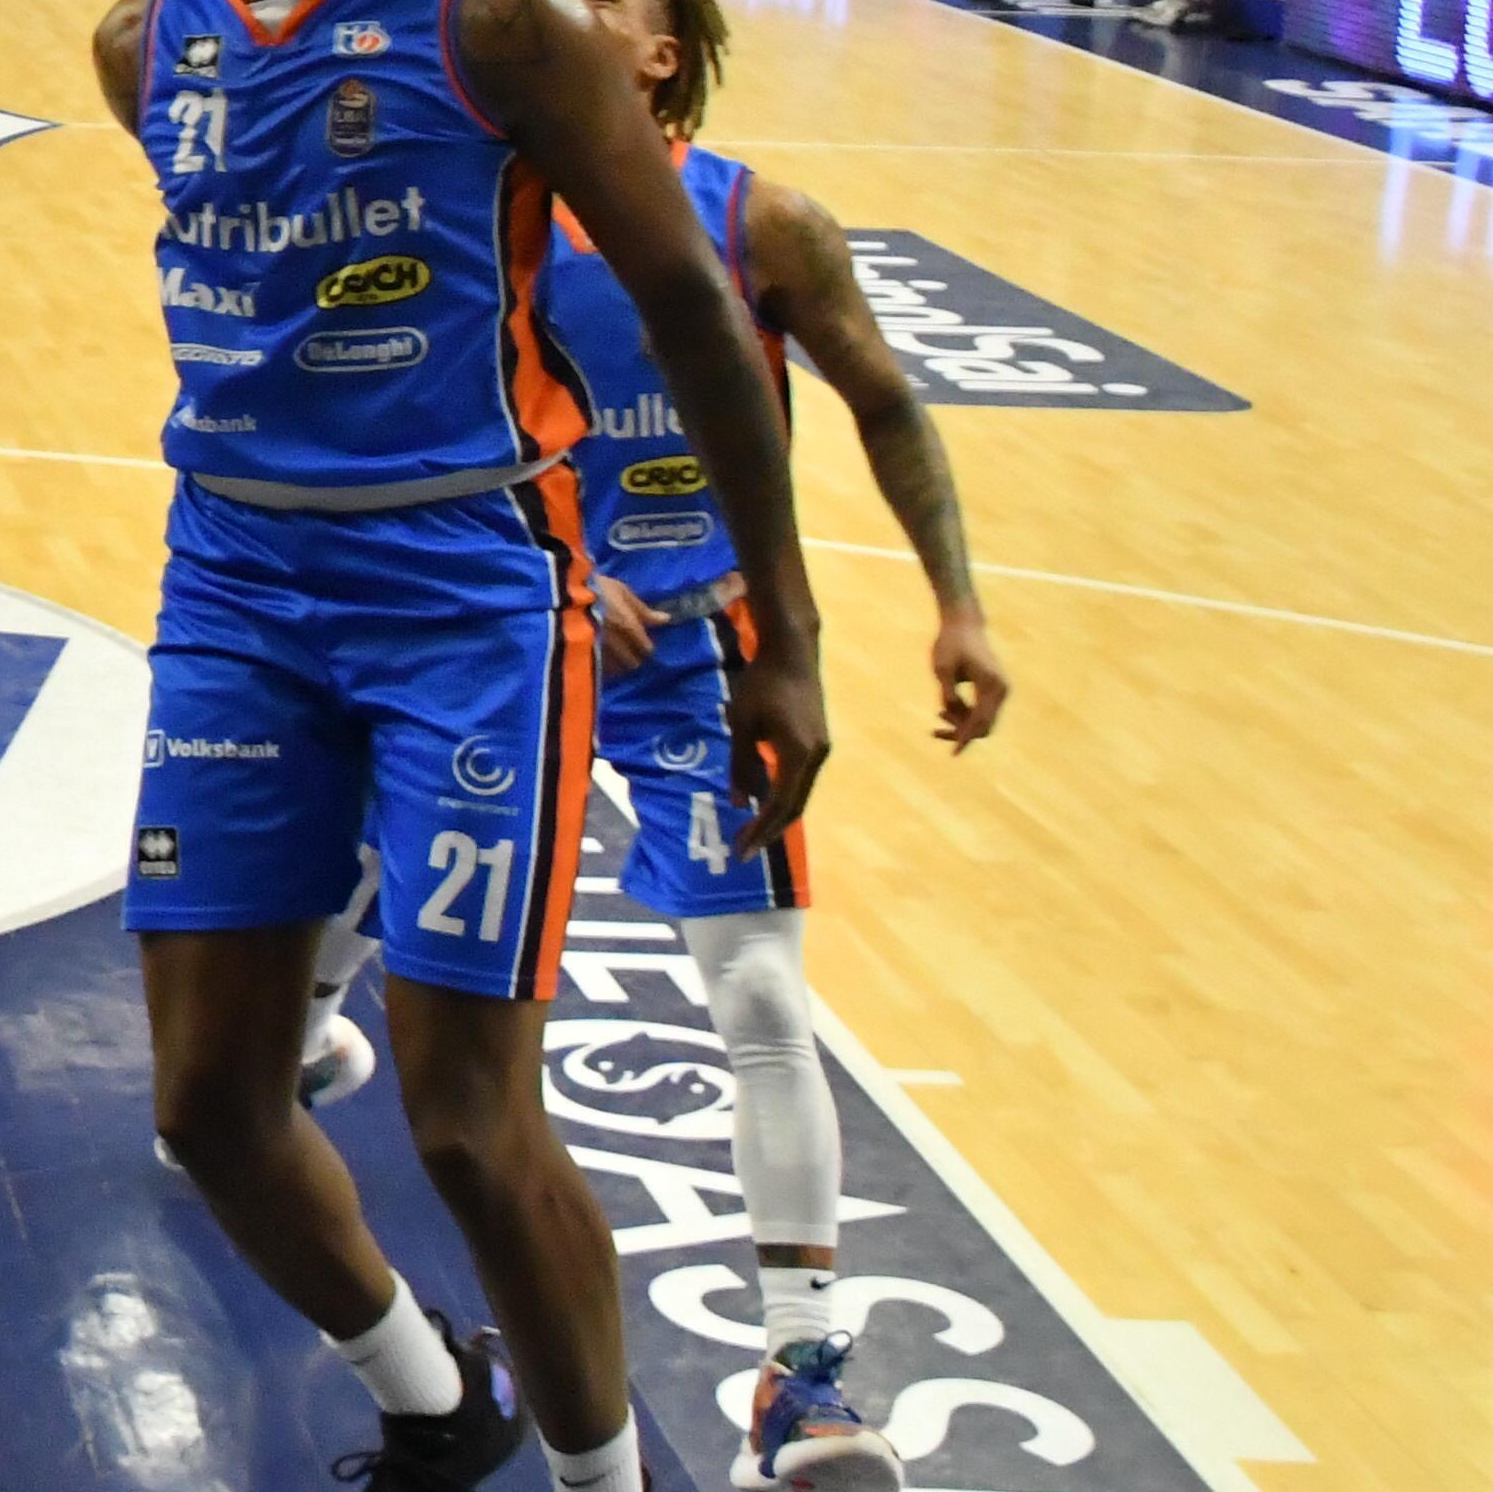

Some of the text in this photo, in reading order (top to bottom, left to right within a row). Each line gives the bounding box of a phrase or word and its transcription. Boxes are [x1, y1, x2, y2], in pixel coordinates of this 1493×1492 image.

[168, 89, 228, 174] 21
[166, 737, 281, 760] Volksbank
[687, 791, 730, 875] 4
[417, 830, 514, 943] 21
